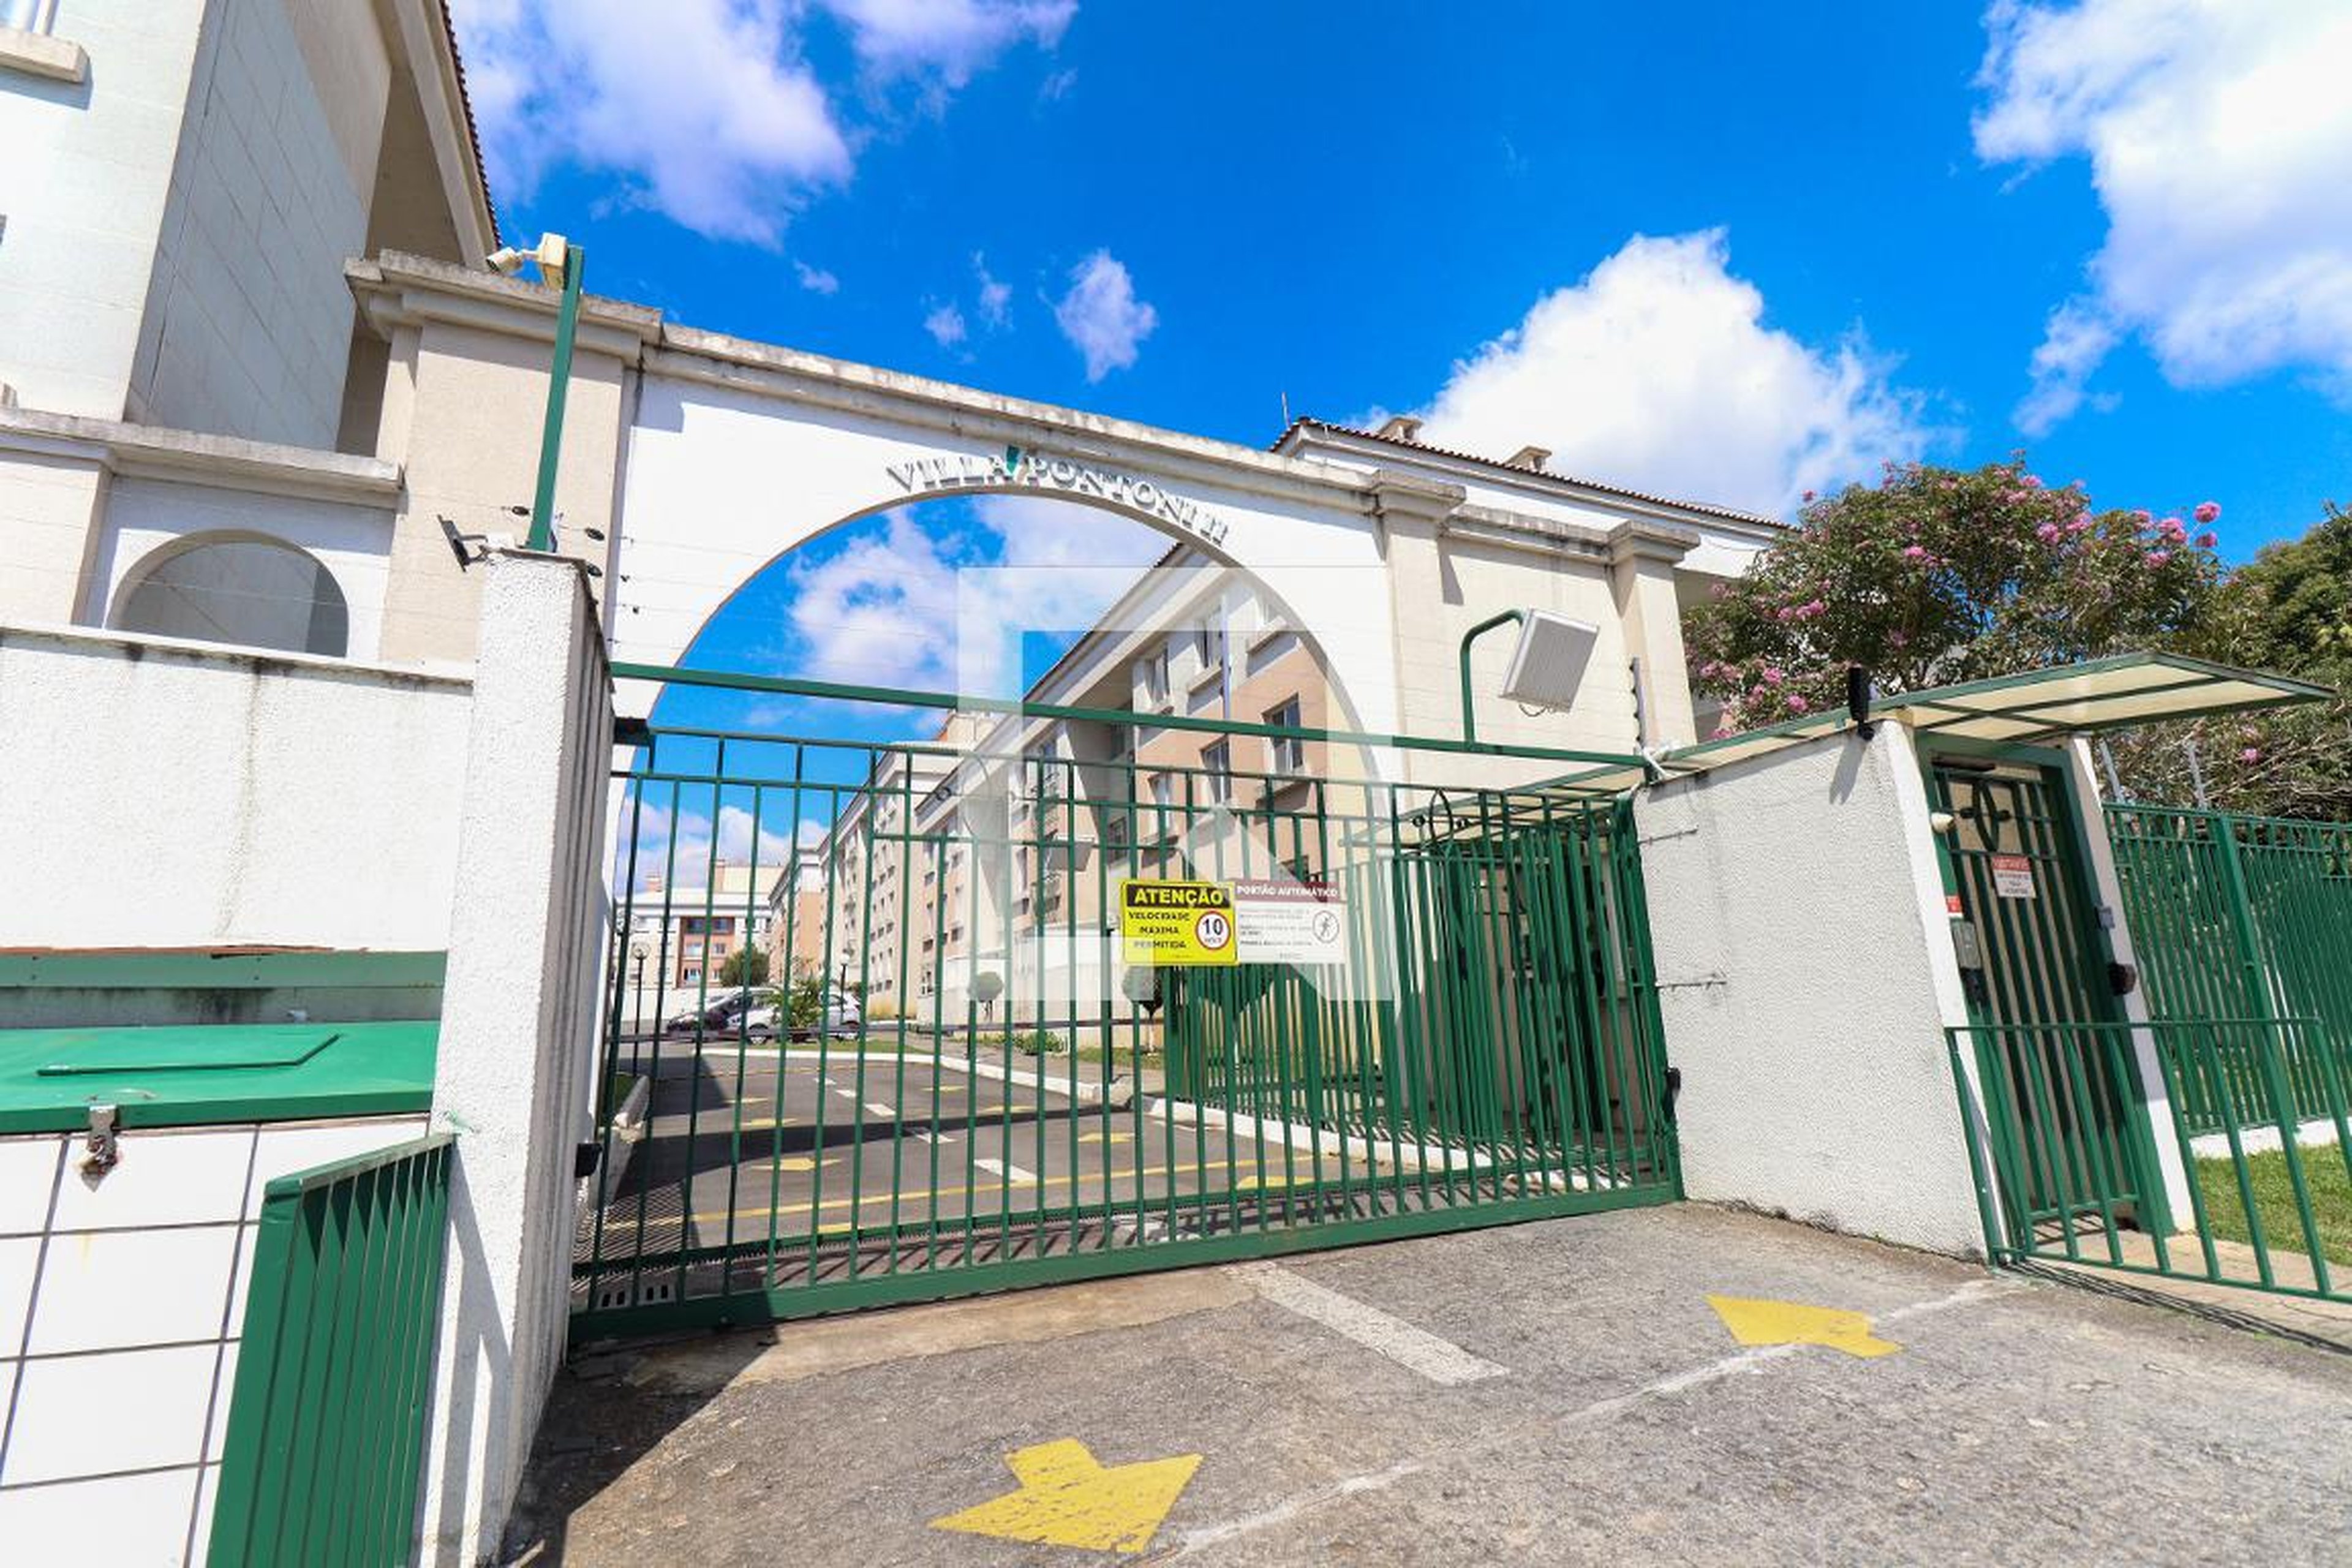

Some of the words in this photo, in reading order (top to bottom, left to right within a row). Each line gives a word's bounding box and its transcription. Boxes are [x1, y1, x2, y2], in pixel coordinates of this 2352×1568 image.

[886, 453, 1014, 492] VILLA
[1236, 884, 1276, 895] PORTÃO
[1134, 887, 1224, 908] ATENÇÃO
[1128, 911, 1191, 921] VELOCIDADE
[1202, 918, 1224, 936] 10
[1134, 940, 1187, 949] PERMITIDA
